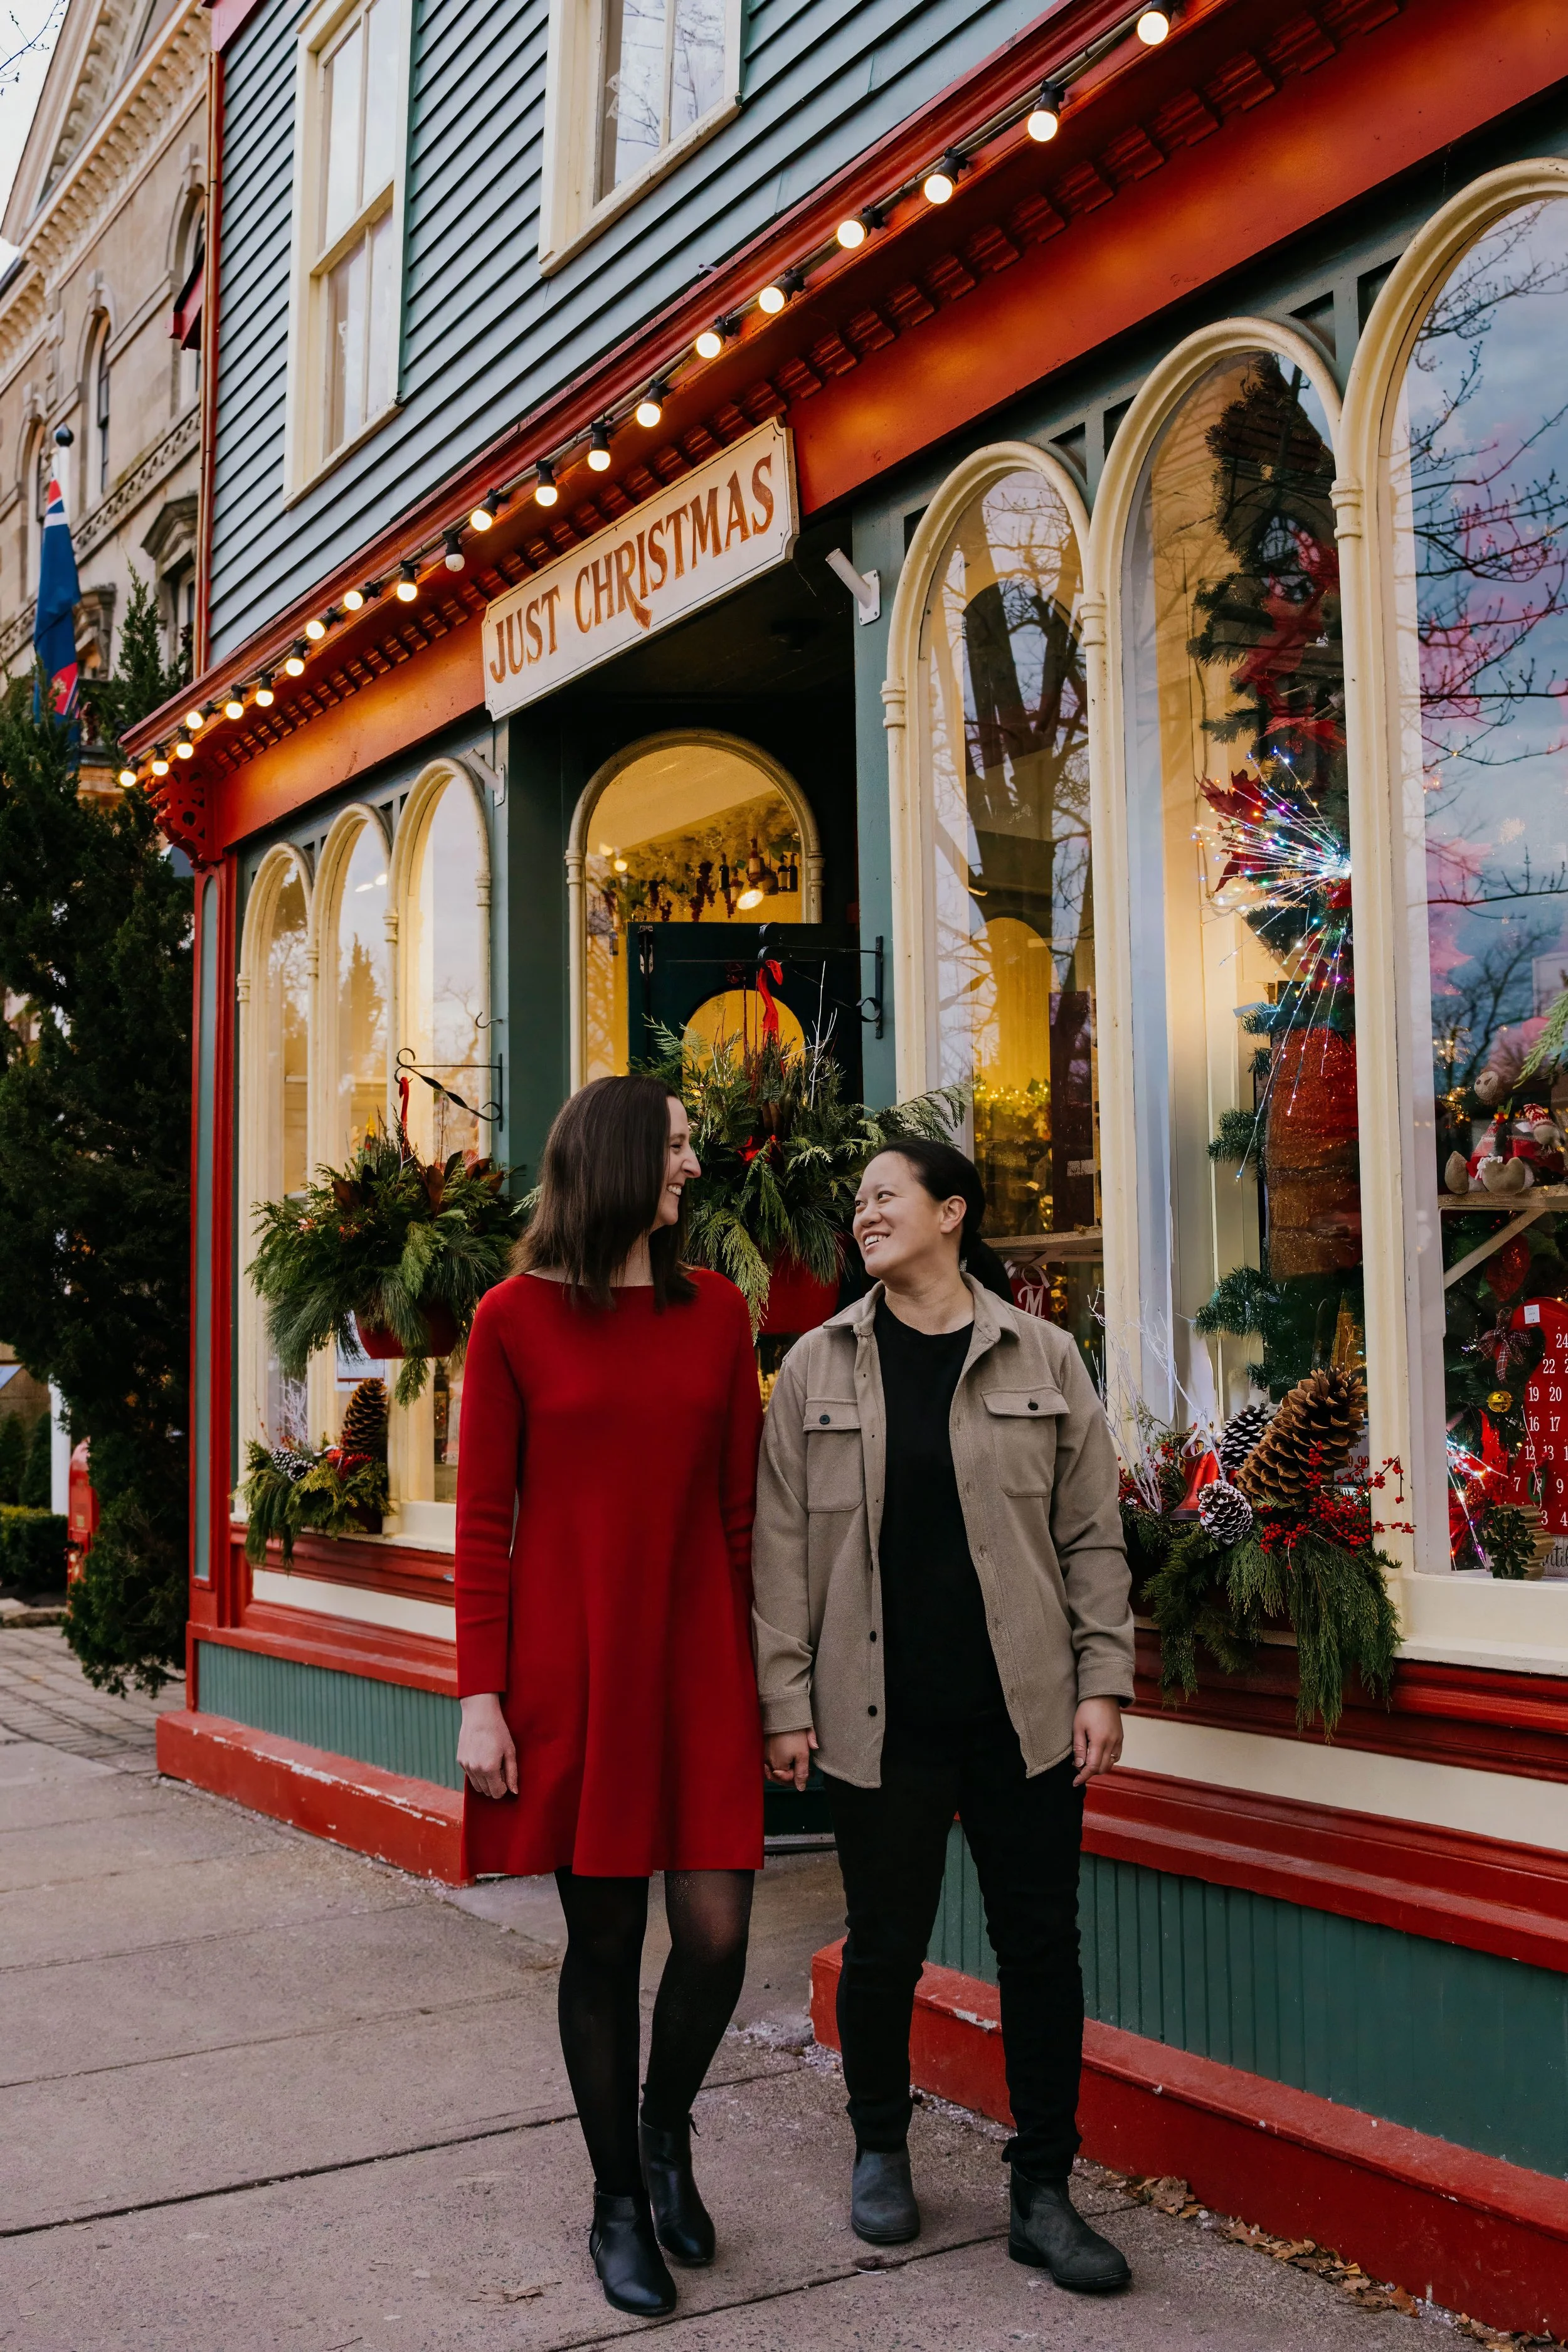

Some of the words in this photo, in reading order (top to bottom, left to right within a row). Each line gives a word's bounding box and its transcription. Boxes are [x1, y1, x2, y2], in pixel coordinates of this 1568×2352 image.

[489, 585, 561, 684] JUST
[575, 452, 775, 631] CHRISTMAS
[1555, 1333, 1568, 1348] 24
[1542, 1359, 1555, 1374] 22
[1528, 1387, 1539, 1402] 19
[1549, 1387, 1562, 1402] 20
[1528, 1416, 1540, 1431] 16
[1550, 1416, 1560, 1432] 17
[1525, 1445, 1535, 1460] 12
[1543, 1445, 1554, 1460] 13
[1513, 1477, 1521, 1491] 7
[1556, 1478, 1564, 1494] 9
[1540, 1510, 1549, 1525] 3
[1560, 1511, 1568, 1527] 4
